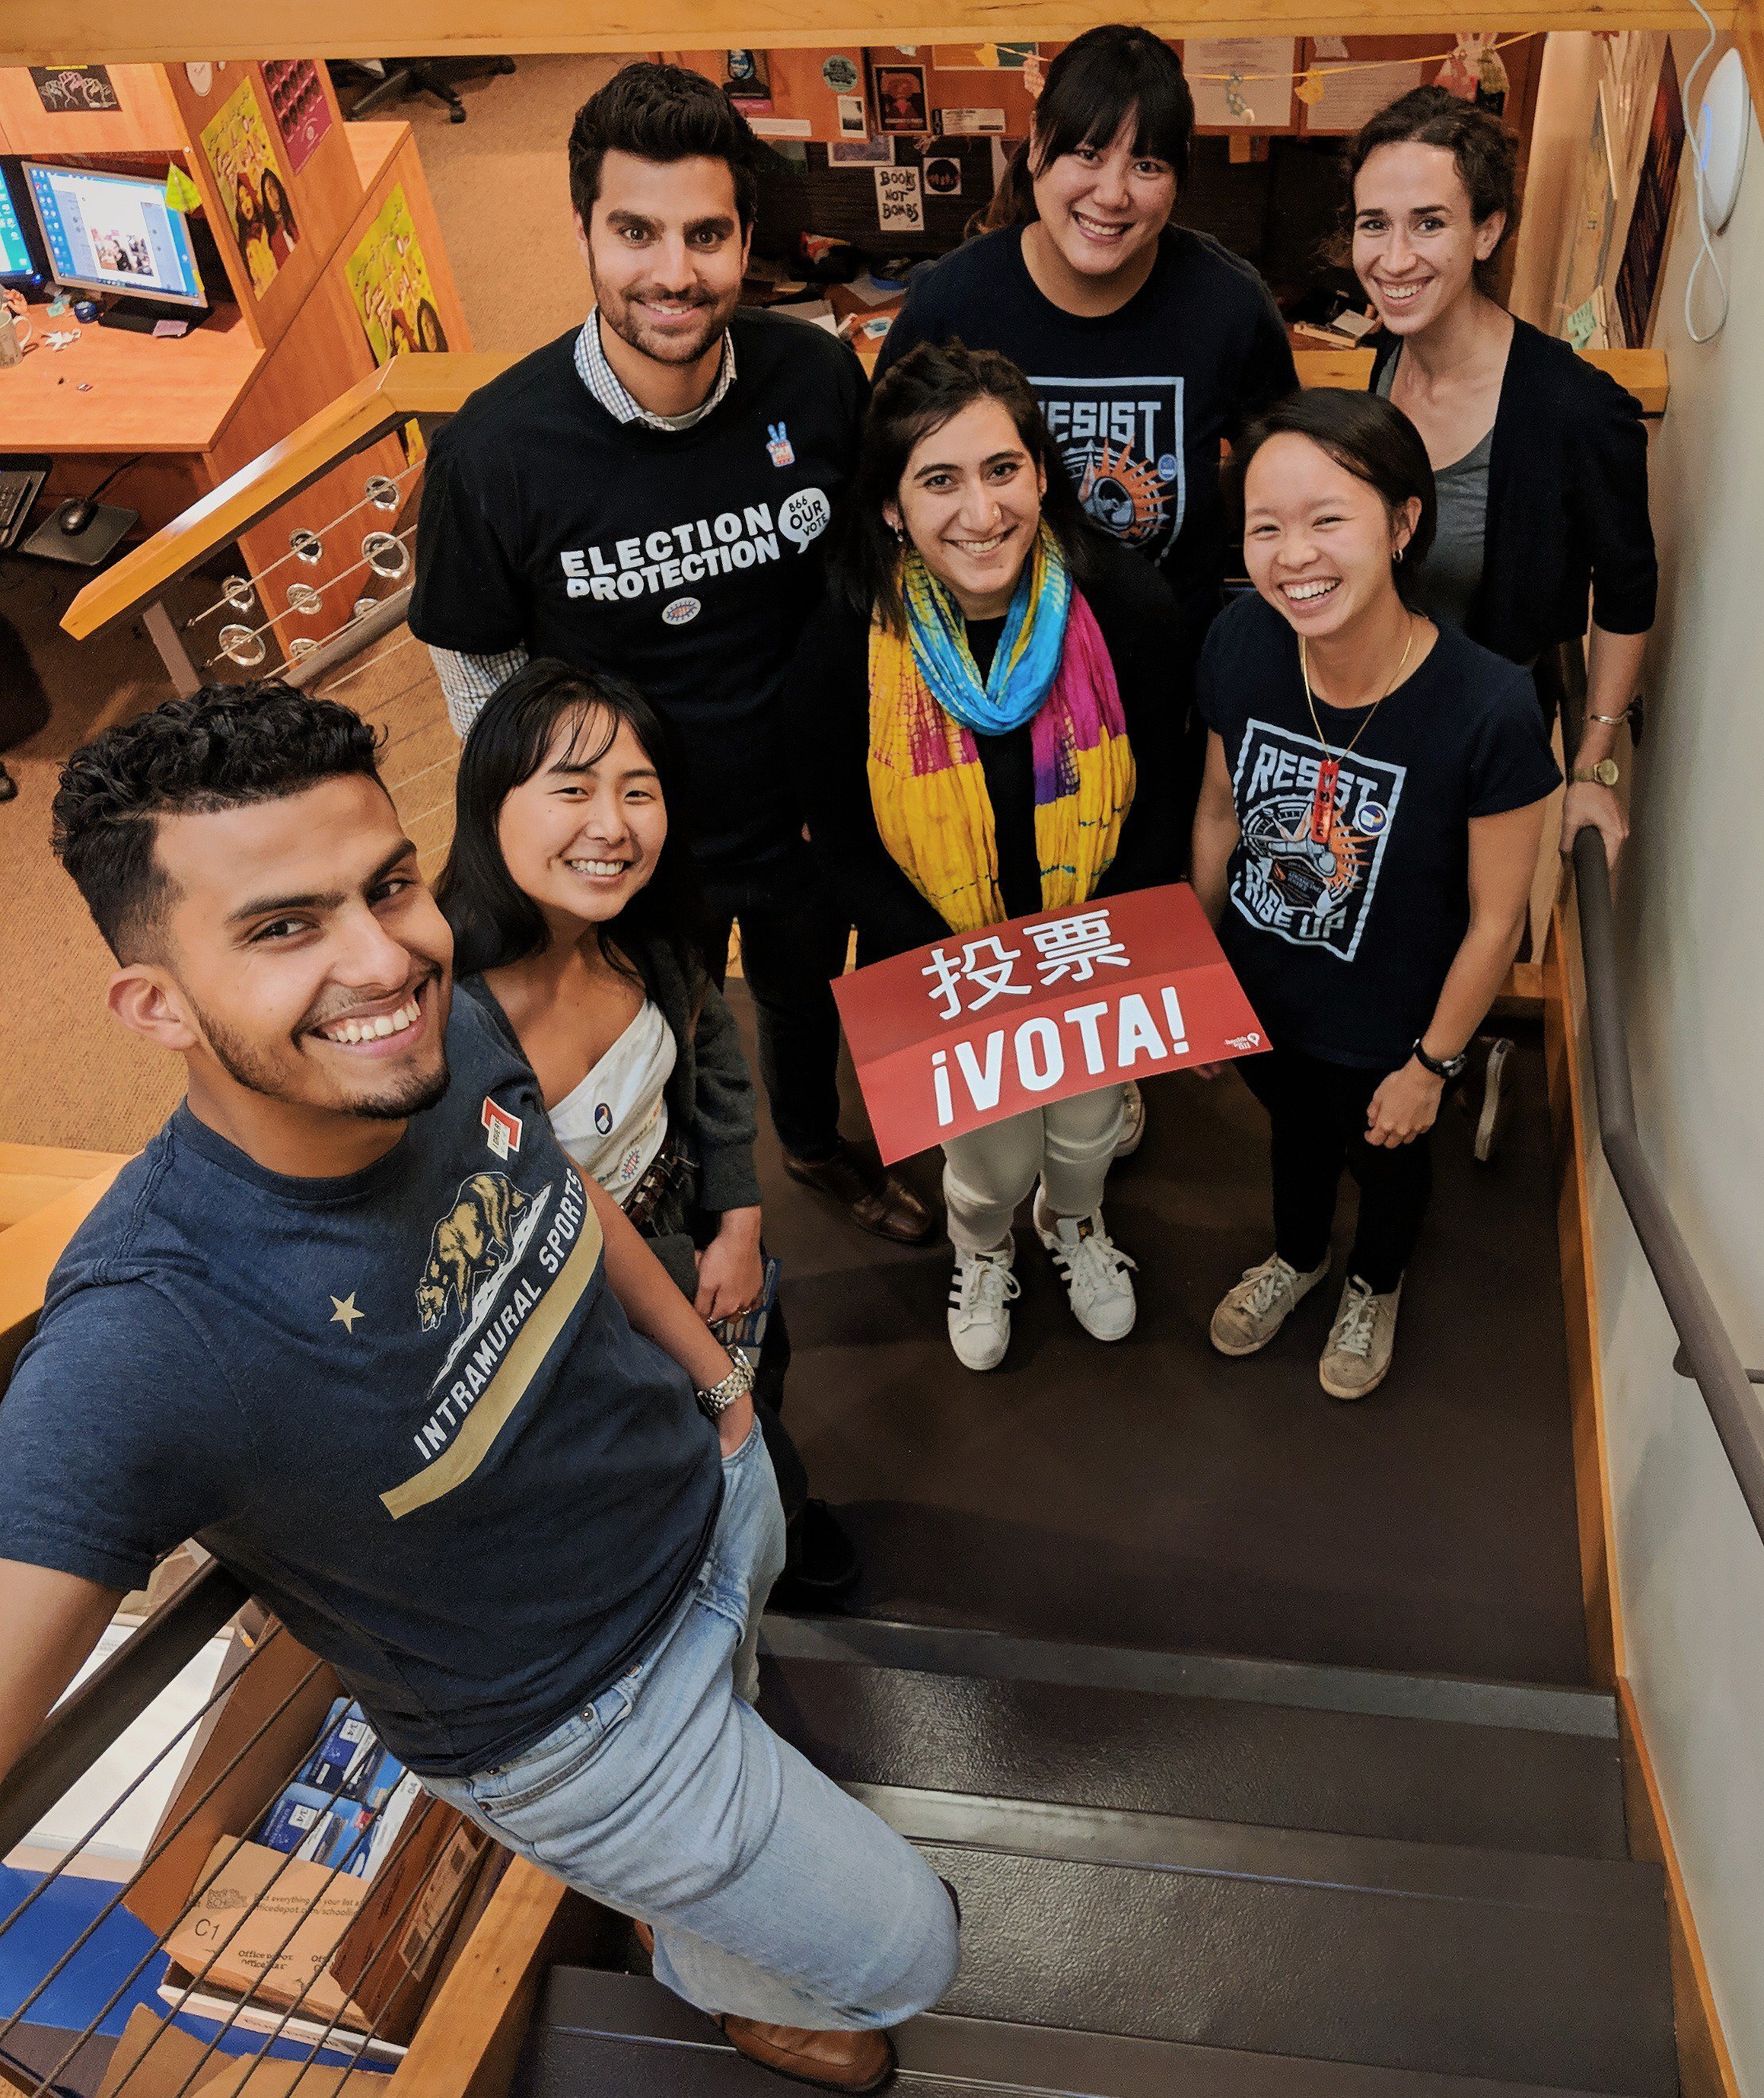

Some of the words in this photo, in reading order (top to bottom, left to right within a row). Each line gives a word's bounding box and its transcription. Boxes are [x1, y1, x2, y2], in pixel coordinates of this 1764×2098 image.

[560, 503, 773, 577] ELECTION
[789, 496, 807, 513] 866
[790, 500, 823, 530] OUR
[802, 513, 829, 536] VOTE
[566, 533, 780, 601] PROTECTION
[1246, 743, 1379, 829] RESST
[1244, 858, 1294, 928] RISE
[1299, 906, 1348, 939] UP
[920, 909, 1131, 1020] 投票
[931, 986, 1190, 1126] ¡VOTA!
[413, 1278, 542, 1460] INTRAMURAL
[539, 1168, 585, 1273] SPORTS
[194, 1918, 220, 1940] C1
